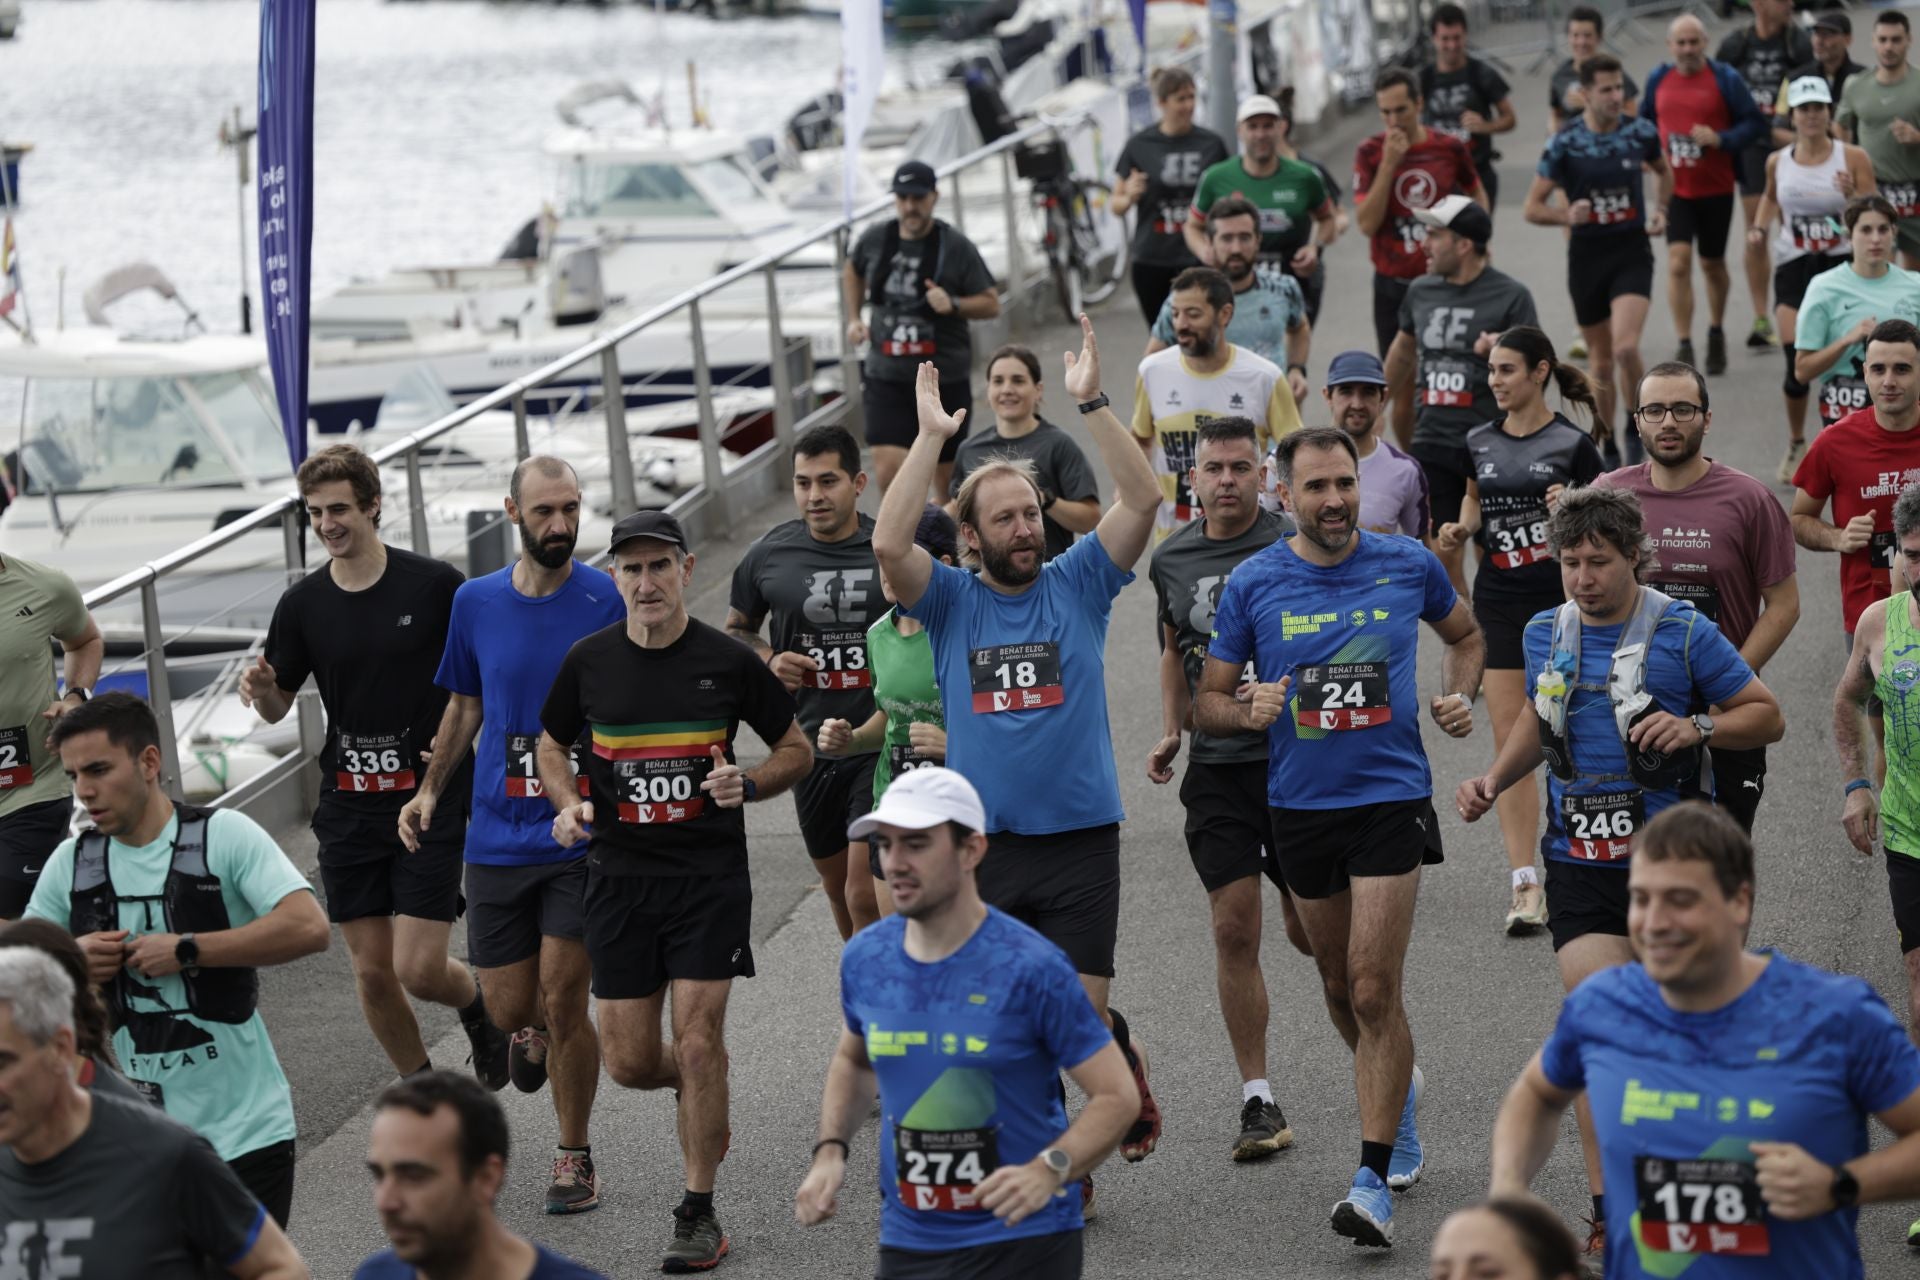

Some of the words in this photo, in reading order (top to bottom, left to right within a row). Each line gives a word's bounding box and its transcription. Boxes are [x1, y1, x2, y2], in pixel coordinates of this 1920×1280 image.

[893, 324, 918, 342] 41
[1426, 371, 1465, 392] 100
[1825, 386, 1866, 408] 305
[1879, 472, 1899, 485] 27
[1186, 490, 1197, 506] 1
[1497, 522, 1546, 552] 318
[1662, 538, 1711, 549] maratón
[1882, 546, 1895, 567] 1
[822, 632, 844, 640] BEÑAT
[808, 646, 865, 671] 313
[1000, 646, 1024, 655] BEÑAT
[1025, 645, 1043, 653] ELZO
[995, 662, 1036, 688] 18
[1241, 660, 1258, 684] 4
[1329, 665, 1353, 674] BEÑAT
[1322, 681, 1365, 708] 24
[0, 745, 18, 769] 2
[345, 750, 400, 773] 336
[645, 760, 669, 769] BEÑAT
[628, 775, 691, 803] 300
[1584, 796, 1607, 805] BEÑAT
[1608, 794, 1627, 802] ELZO
[1571, 810, 1633, 839] 246
[905, 1150, 984, 1185] 274
[1655, 1182, 1746, 1224] 178
